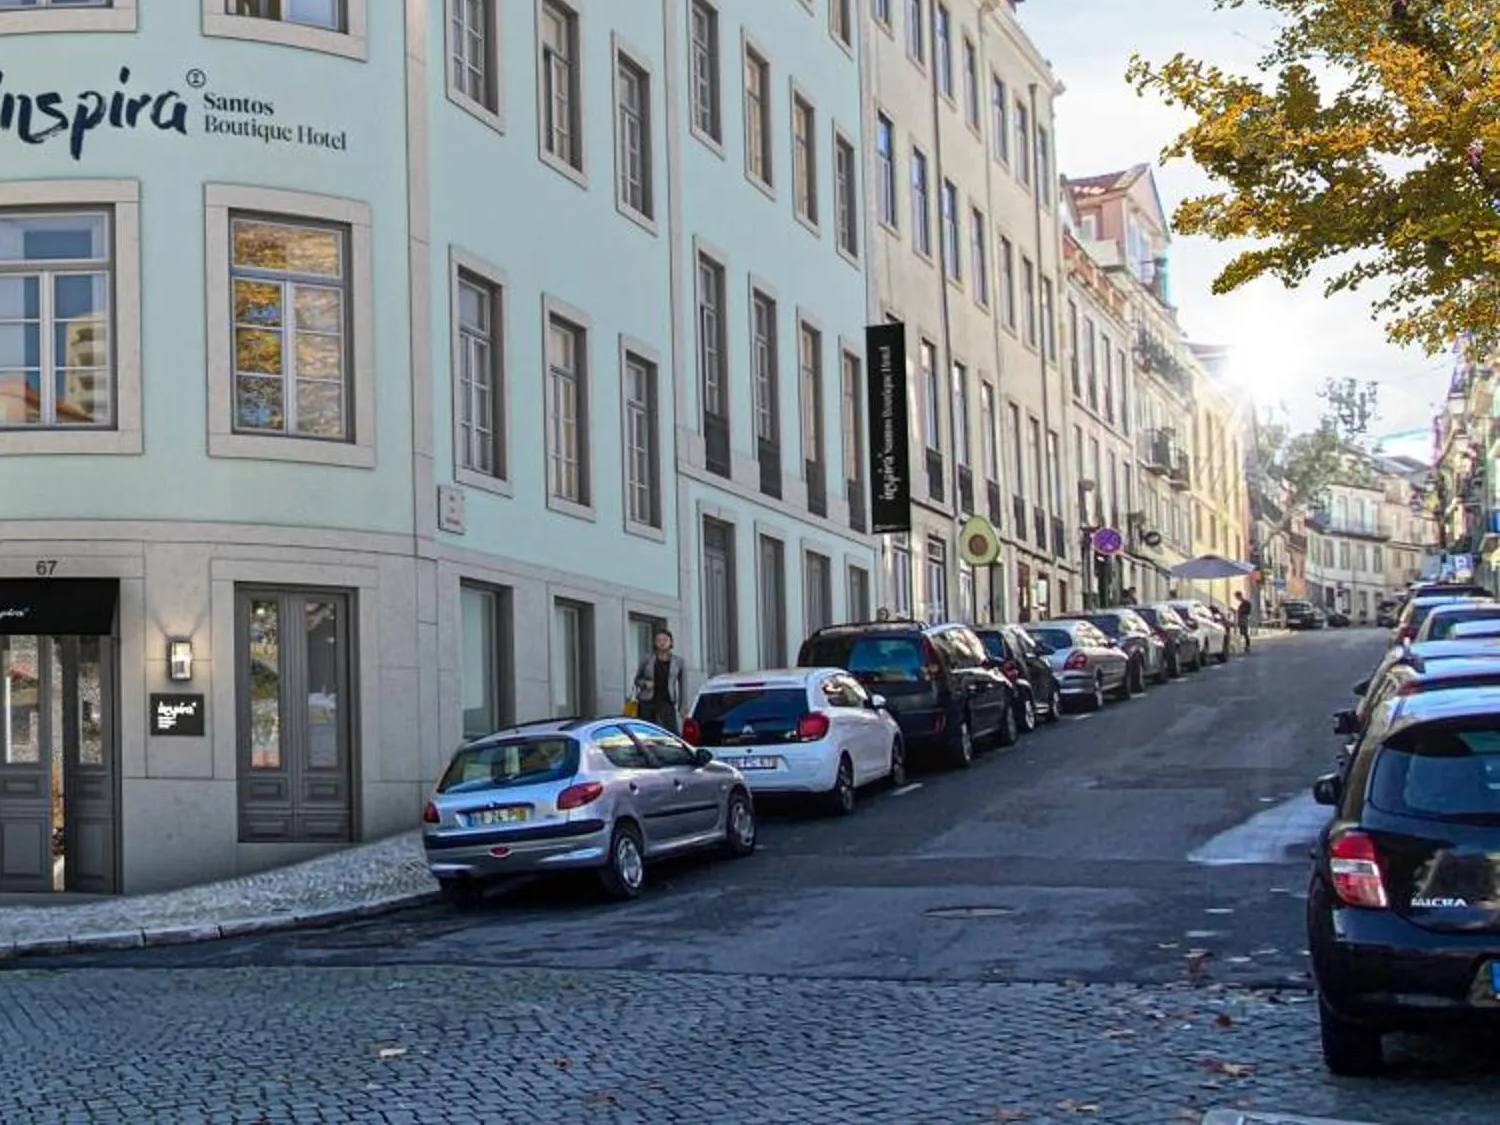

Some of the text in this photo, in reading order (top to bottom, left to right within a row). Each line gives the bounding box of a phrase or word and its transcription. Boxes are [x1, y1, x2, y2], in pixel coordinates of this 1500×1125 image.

[203, 92, 275, 116] Santos
[204, 114, 347, 151] Boutique Hotel
[35, 560, 58, 576] 67
[1411, 897, 1469, 908] MICRA
